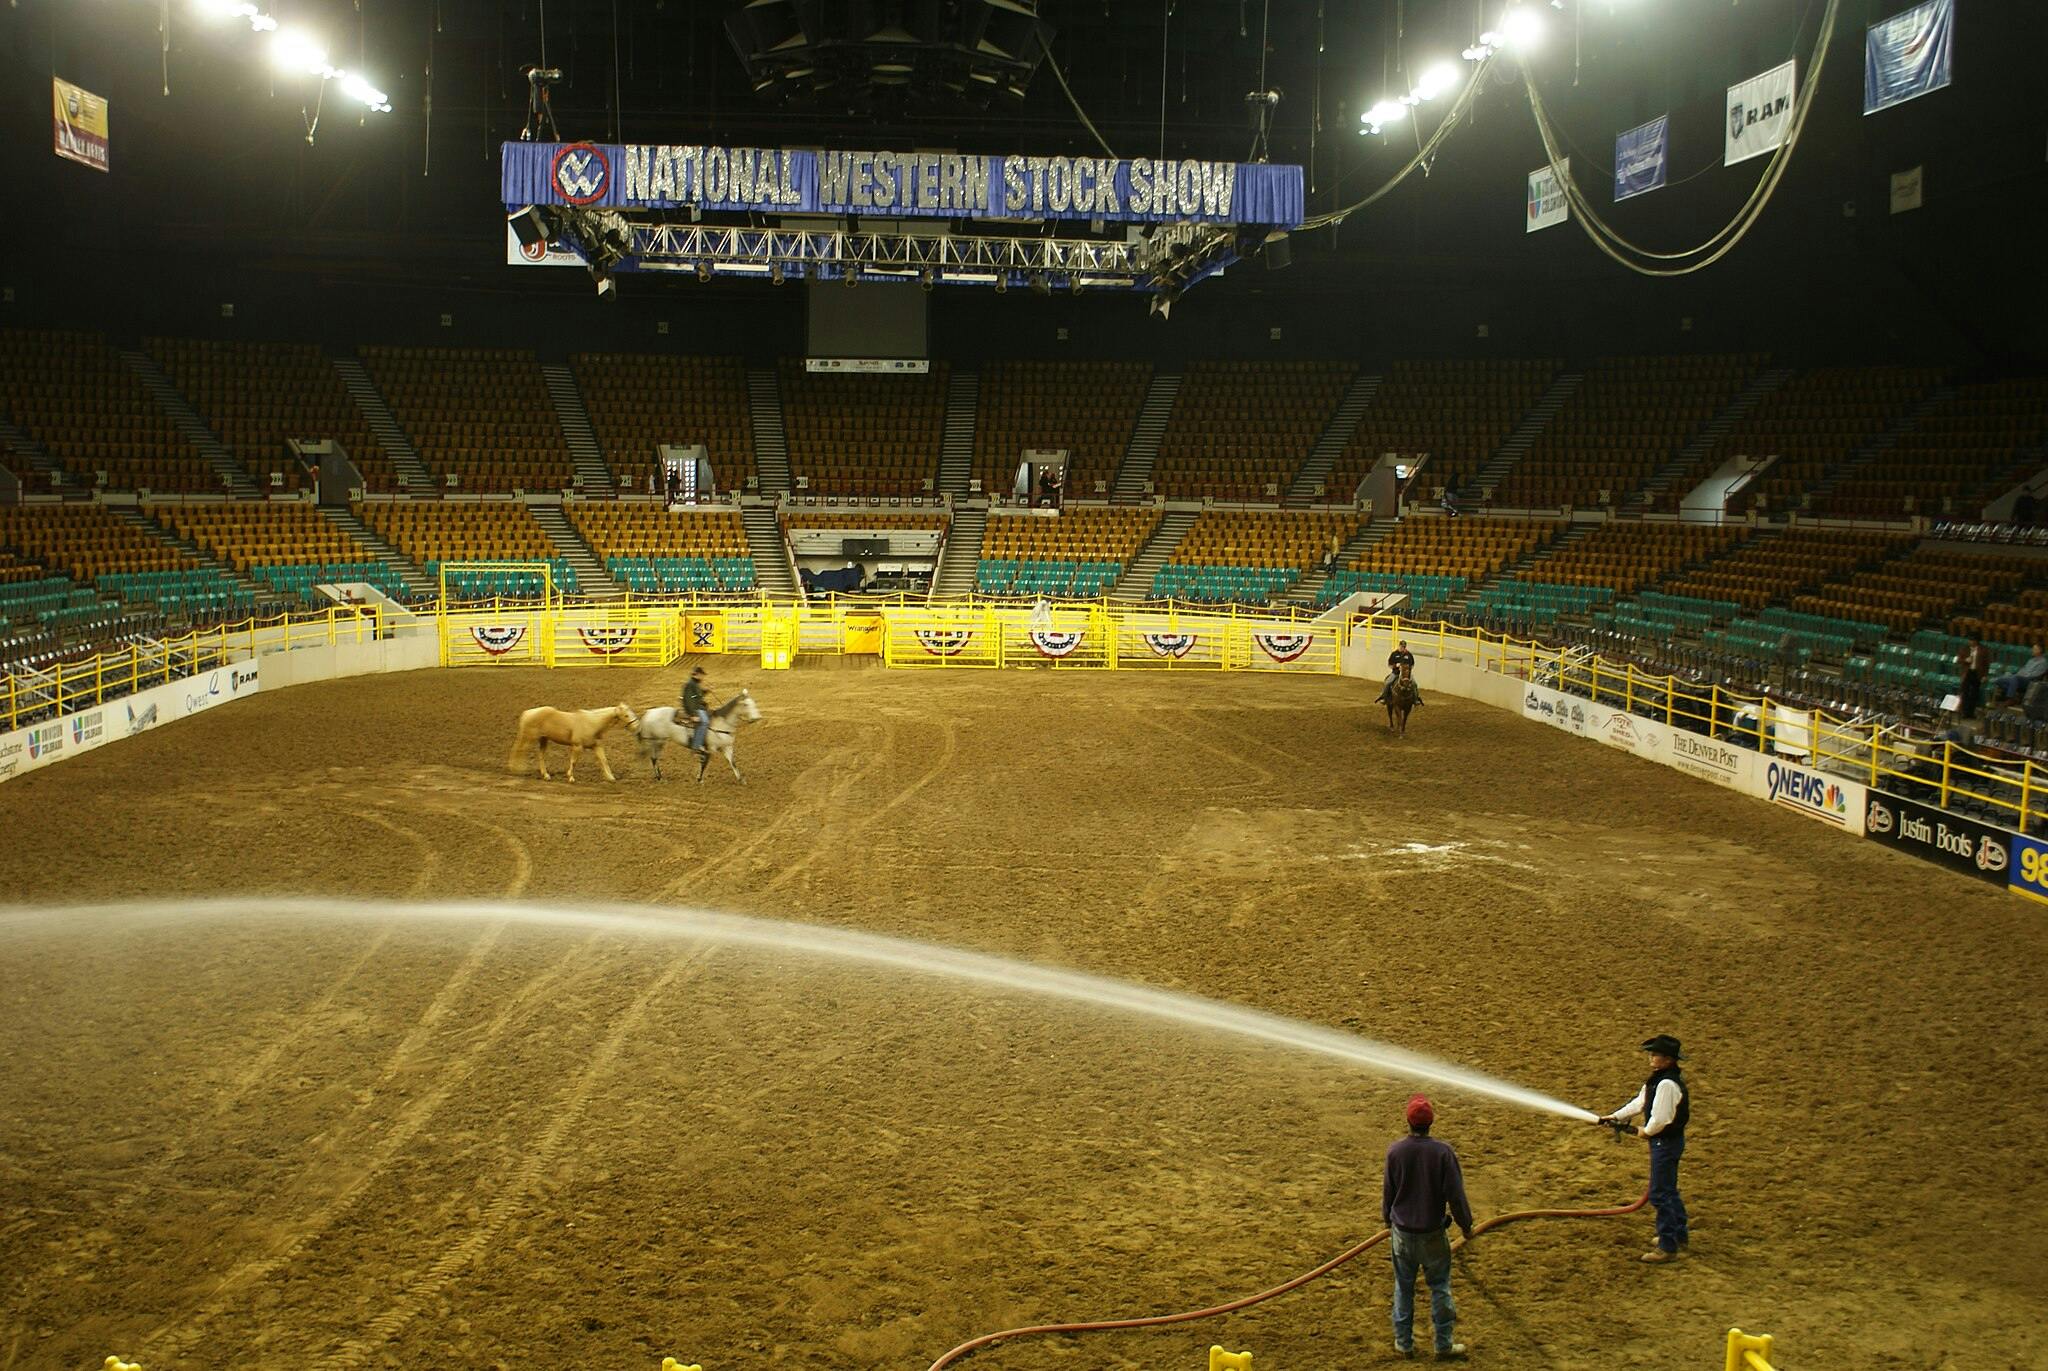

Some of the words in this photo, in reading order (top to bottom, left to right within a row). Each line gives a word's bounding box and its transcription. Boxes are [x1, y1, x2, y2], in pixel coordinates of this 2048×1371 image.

[1746, 94, 1790, 126] RAM
[625, 144, 801, 204] NATIONAL
[816, 151, 989, 209] WESTERN
[1004, 154, 1120, 214] STOCK
[1128, 157, 1236, 217] SHOW
[693, 622, 714, 632] 20
[239, 671, 258, 685] RAM
[1673, 733, 1688, 752] THE
[1689, 738, 1718, 763] DENVER
[1719, 747, 1739, 768] POST
[1767, 762, 1824, 807] 9NEWS
[1897, 811, 1932, 844] Justin
[1936, 823, 1972, 858] Boots
